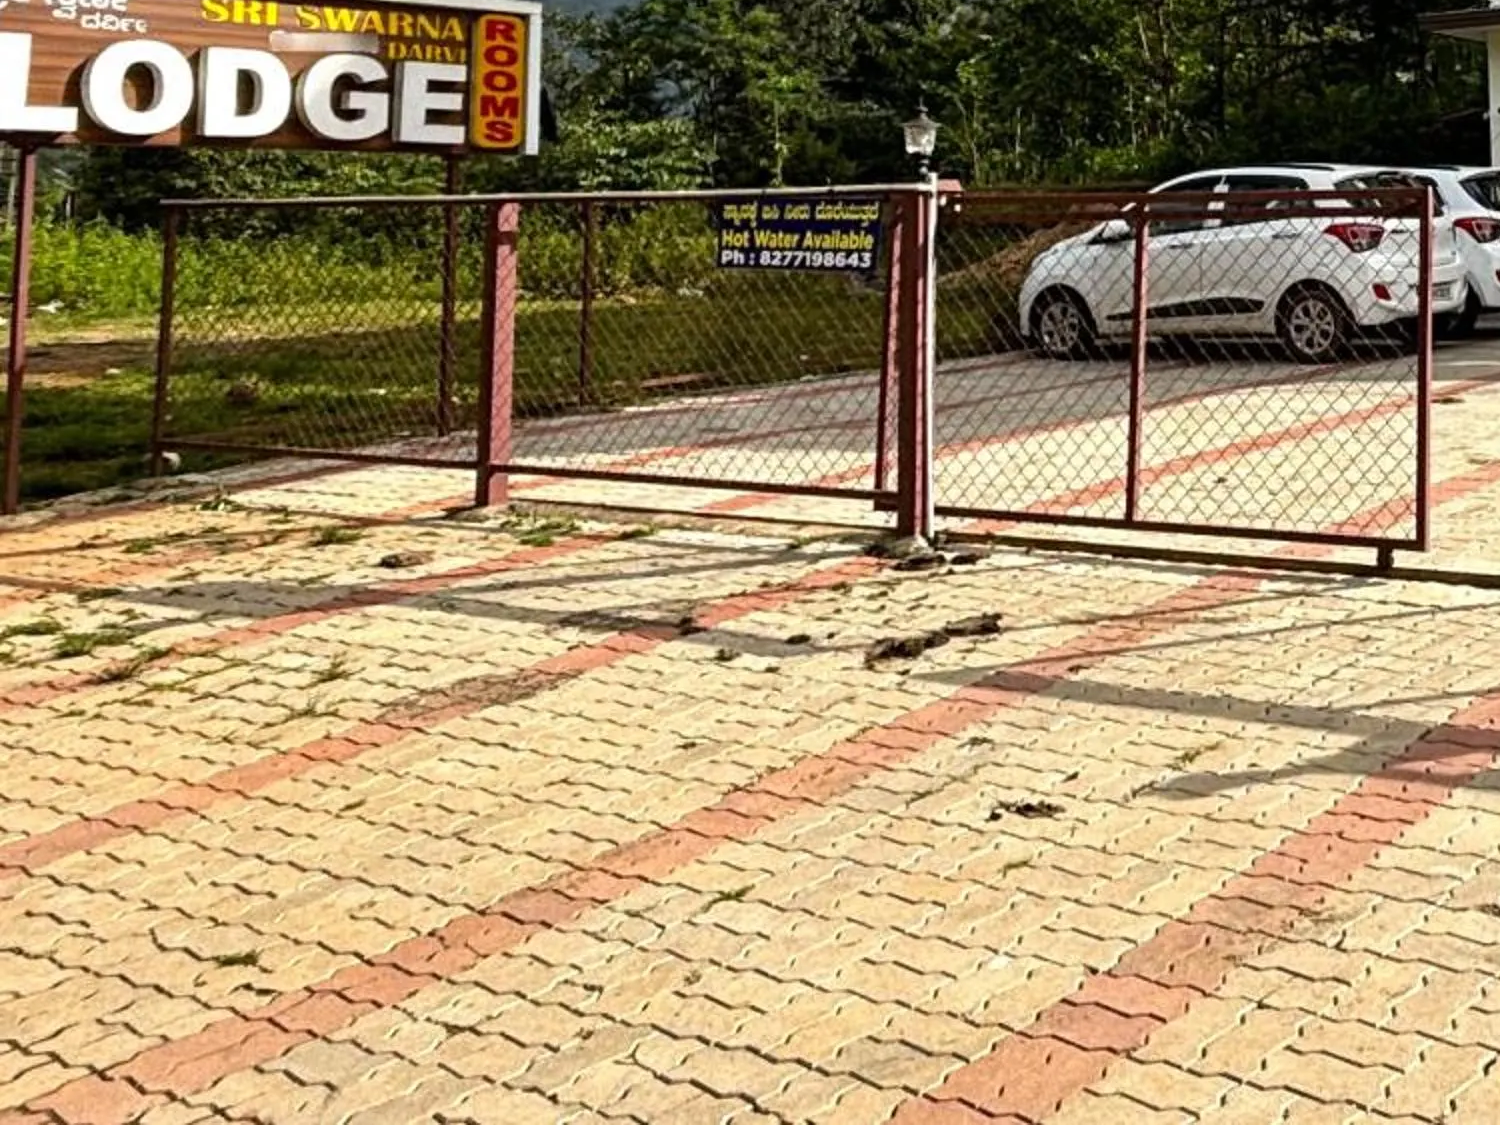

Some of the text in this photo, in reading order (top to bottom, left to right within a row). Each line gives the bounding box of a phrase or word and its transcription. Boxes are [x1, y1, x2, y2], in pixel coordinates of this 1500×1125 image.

[296, 4, 466, 42] SWARNA
[388, 40, 468, 63] DARVI
[0, 32, 468, 145] LODGE
[480, 18, 520, 144] ROOMS
[721, 229, 875, 250] Hot Water Available
[759, 251, 873, 268] 8277198643
